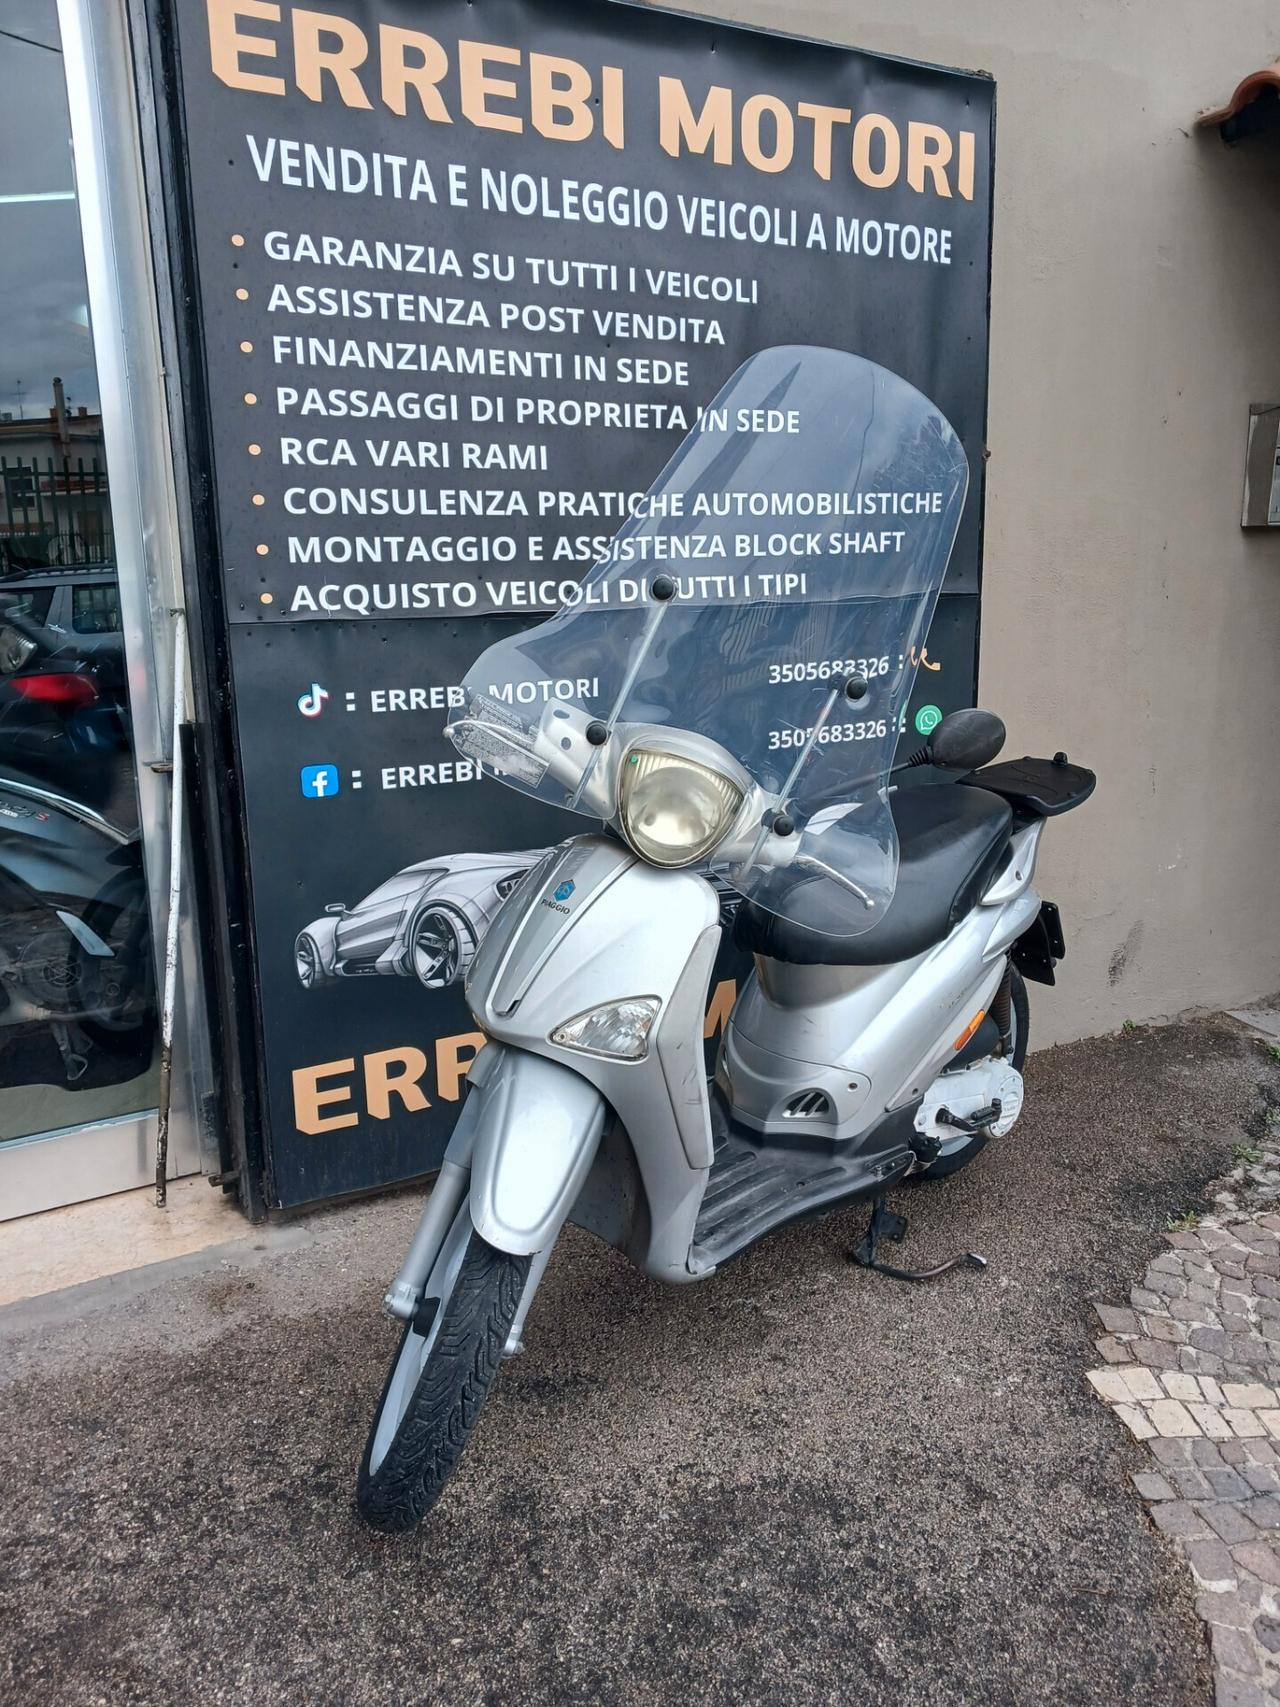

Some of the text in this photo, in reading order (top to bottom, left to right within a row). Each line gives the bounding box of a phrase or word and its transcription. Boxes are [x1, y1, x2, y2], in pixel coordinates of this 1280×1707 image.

[207, 0, 975, 200] ERREBI MOTORI
[246, 134, 952, 264] VENDITA E NOLEGGIO VEICOLI A MOTORE
[263, 231, 758, 304] GARANZIA SU TUTTI I VEICOLI
[267, 284, 725, 345] ASSISTENZA POST VENDITA
[273, 336, 689, 386] FINANZIAMENTI IN SEDE
[276, 386, 800, 433] PASSAGGI DI PROPRIETA IN SEDE
[280, 437, 548, 470] RCA VARI RAMI
[283, 487, 943, 519] CONSULENZA PRATICHE AUTOMOBILISTICHE
[288, 531, 905, 564] MONTAGGIO E ASSISTENZA BLOCK SHAFT
[290, 573, 807, 615] ACQUISTO VEICOLI DI UTTI I TIPI
[370, 685, 473, 713] ERREB
[488, 677, 599, 705] MOTORI
[381, 758, 482, 790] ERREBI
[540, 898, 571, 915] PIAGGIO
